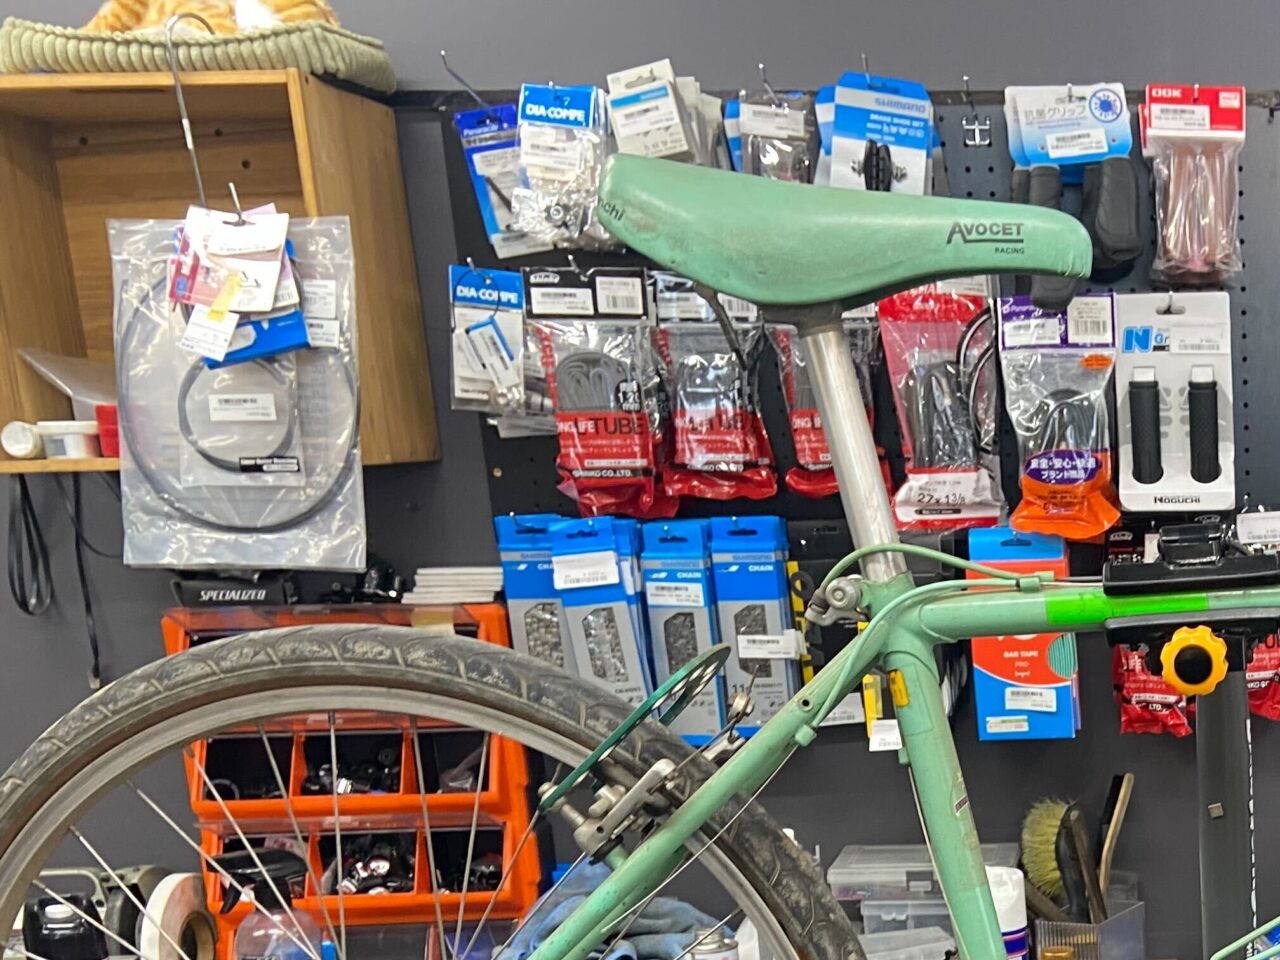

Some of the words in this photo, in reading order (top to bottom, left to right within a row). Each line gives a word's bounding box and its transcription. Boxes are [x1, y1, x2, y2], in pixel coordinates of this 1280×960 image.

[947, 221, 1025, 244] AVOCET
[995, 246, 1025, 255] RACING
[1153, 496, 1201, 504] NOGUCHI
[199, 589, 267, 601] SPECIALIZED
